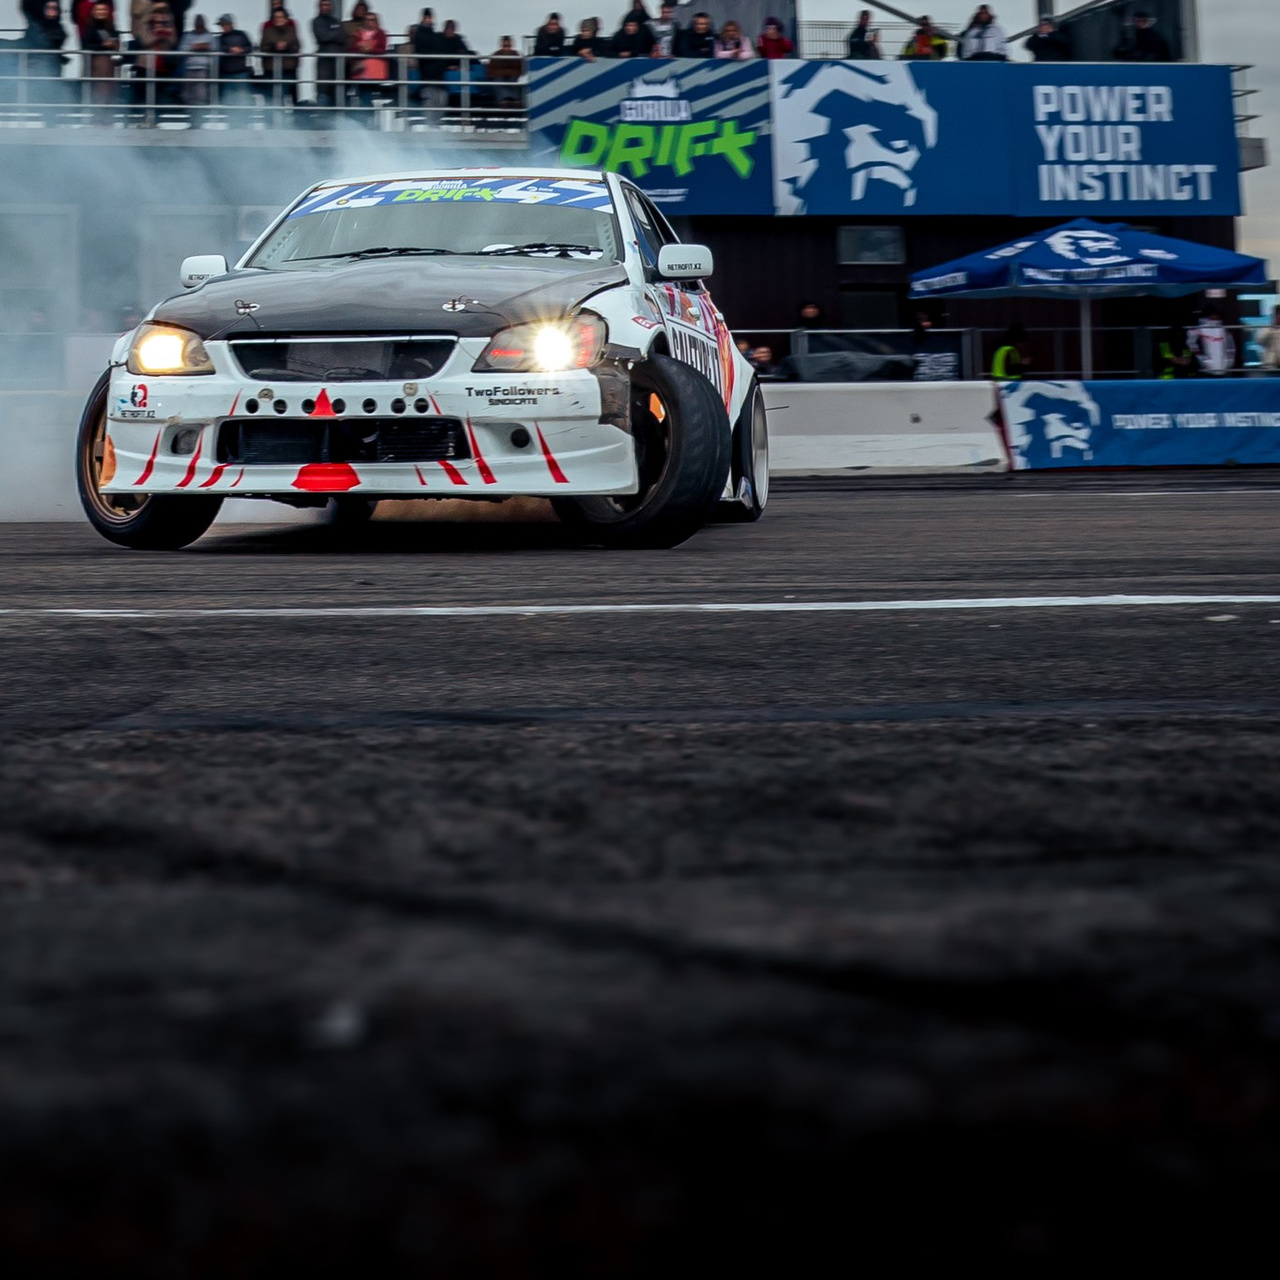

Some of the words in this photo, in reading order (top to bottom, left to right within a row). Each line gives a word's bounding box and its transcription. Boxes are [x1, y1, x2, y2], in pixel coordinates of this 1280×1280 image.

[621, 100, 692, 121] GORILLA
[1033, 85, 1174, 122] POWER
[560, 119, 757, 179] DRIFT
[1034, 125, 1143, 161] YOUR
[393, 186, 501, 202] DRIFT
[1038, 164, 1218, 202] INSTINCT
[465, 386, 560, 397] TwoFollowers
